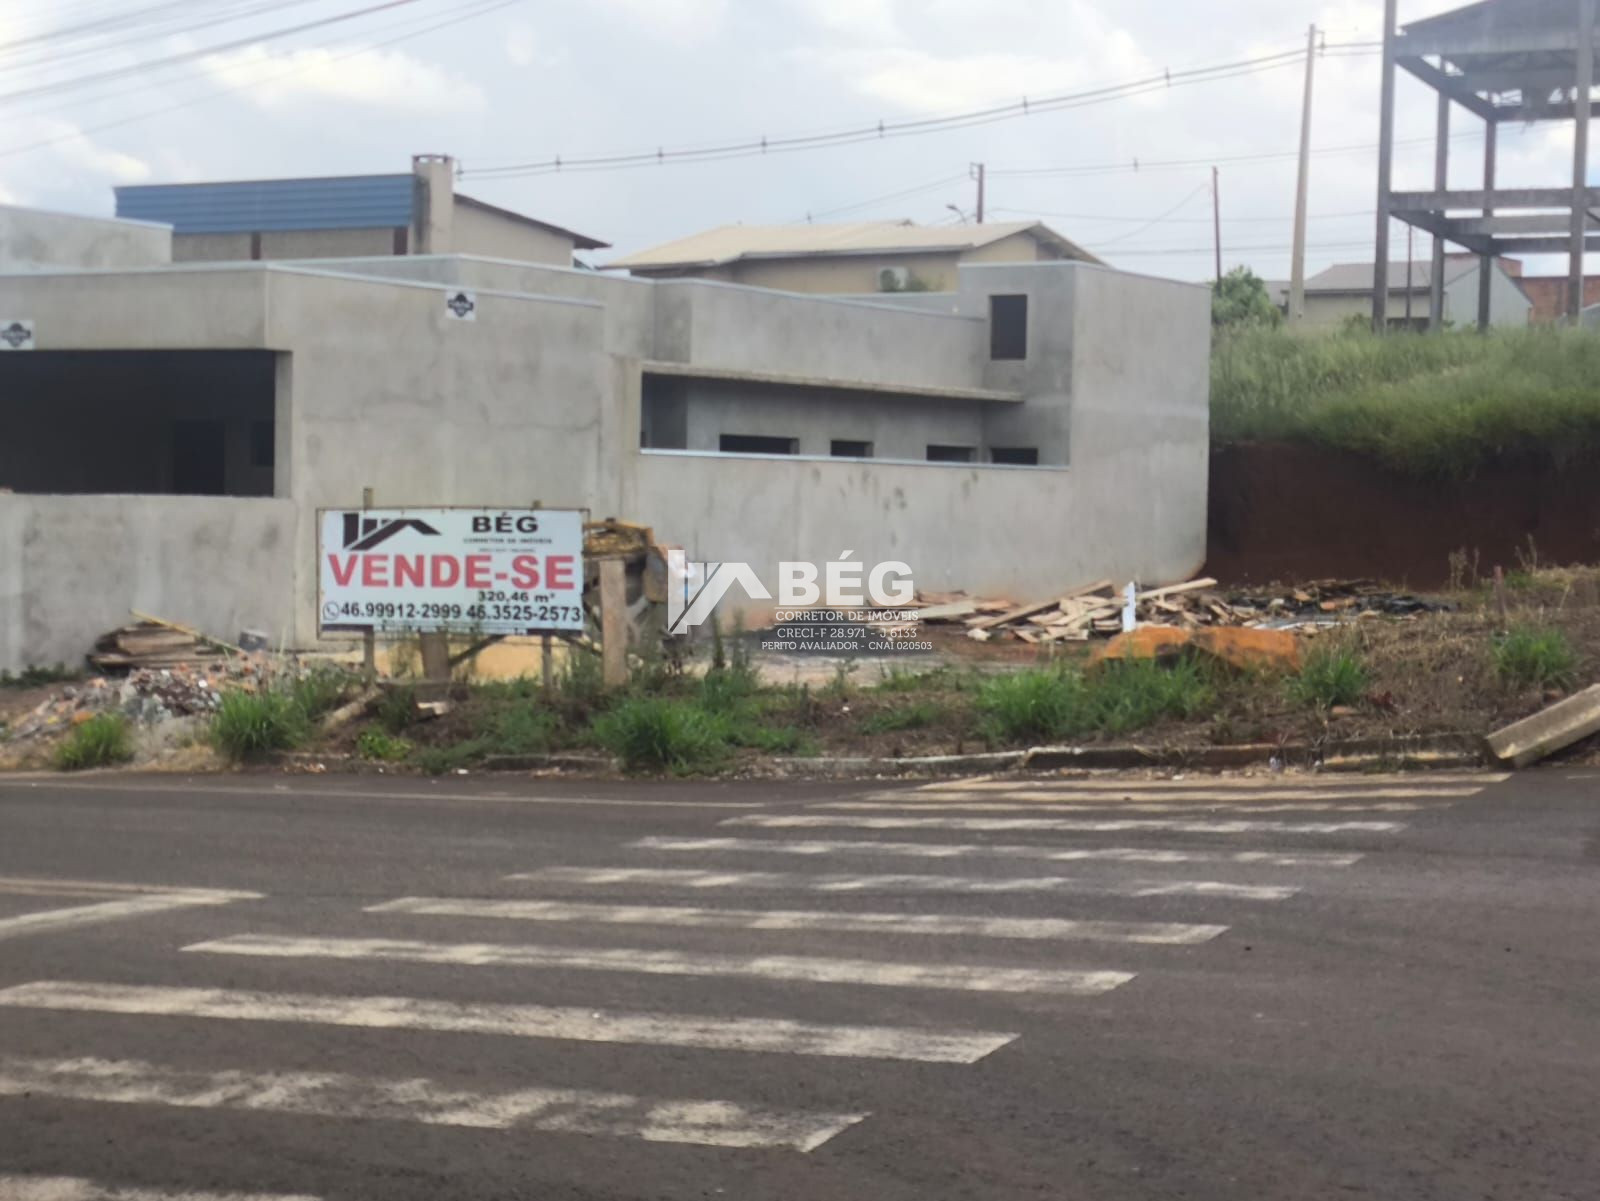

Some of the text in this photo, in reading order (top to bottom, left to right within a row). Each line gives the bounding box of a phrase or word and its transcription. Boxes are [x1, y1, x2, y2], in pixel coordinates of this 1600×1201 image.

[472, 512, 539, 533] BÉG
[328, 554, 575, 590] VENDE-SE
[340, 602, 581, 621] 46.99912-2999 46.3525-2573
